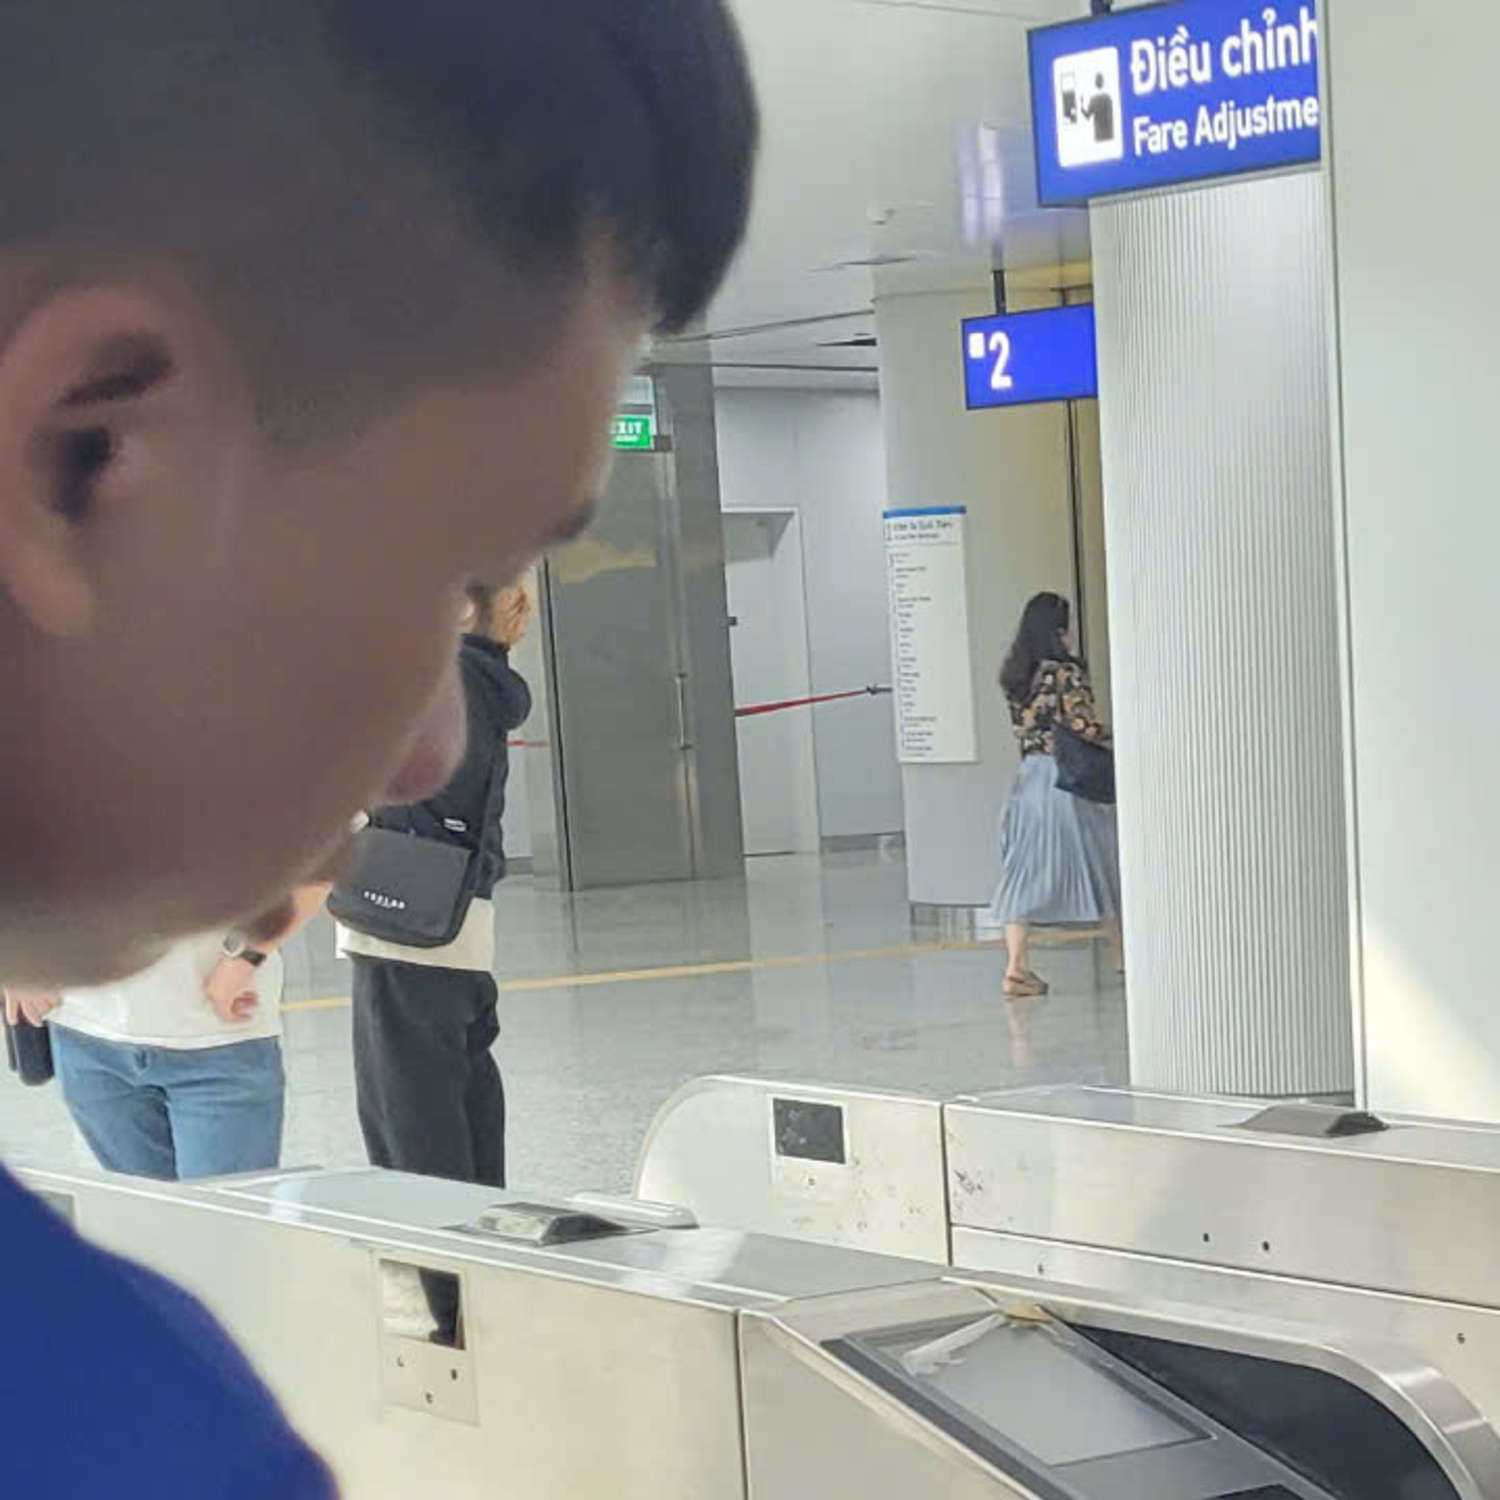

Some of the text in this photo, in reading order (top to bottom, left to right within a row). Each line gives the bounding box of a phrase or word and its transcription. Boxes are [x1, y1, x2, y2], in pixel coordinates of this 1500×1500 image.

[1130, 6, 1317, 95] Điều chỉnh
[1132, 94, 1318, 157] Fare Adjustme
[988, 331, 1013, 389] 2
